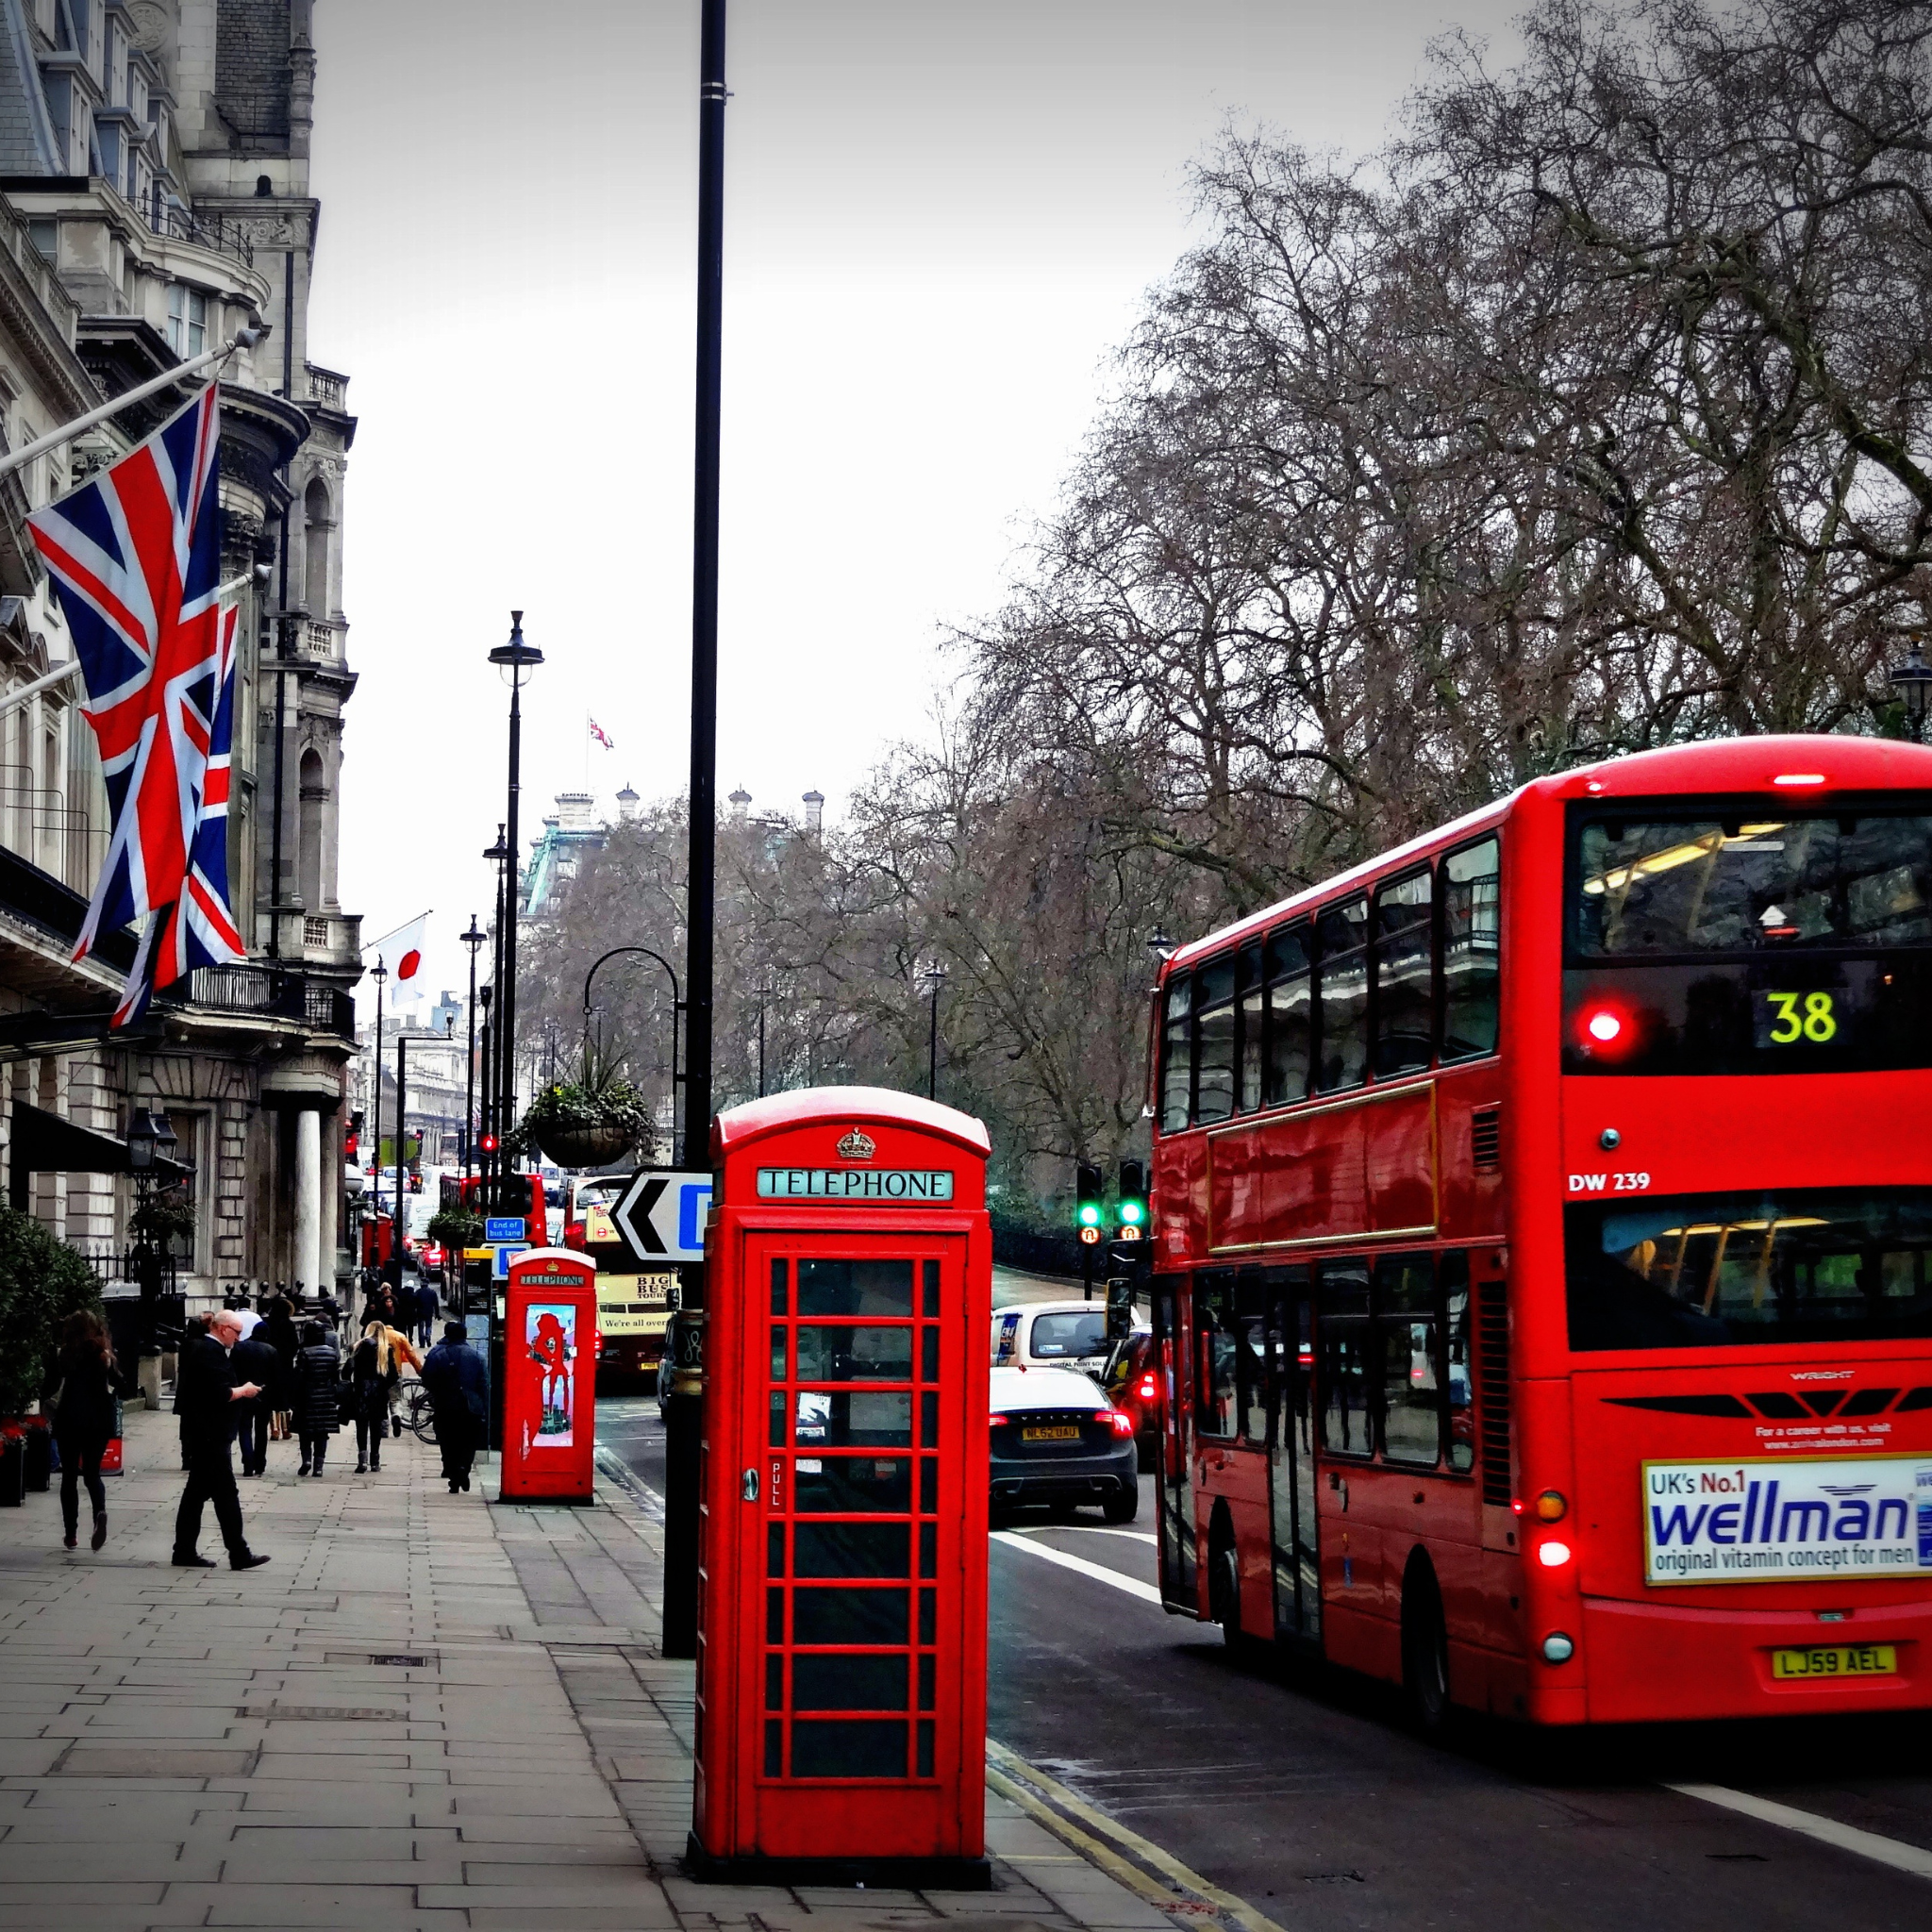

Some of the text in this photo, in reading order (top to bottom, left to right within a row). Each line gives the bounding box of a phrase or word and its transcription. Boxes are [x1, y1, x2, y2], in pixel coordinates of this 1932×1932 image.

[1767, 991, 1837, 1043] 38
[764, 1171, 945, 1196] TELEPHONE
[1568, 1173, 1651, 1191] DW 239
[524, 1275, 583, 1285] TELEPHONE
[637, 1276, 669, 1285] BIG
[637, 1285, 668, 1293] BUS
[1756, 1426, 1774, 1437] For
[1652, 1470, 1745, 1494] UK's No.1
[1651, 1480, 1908, 1546] wellman
[1656, 1543, 1914, 1575] original vitamin concept for men
[1781, 1650, 1887, 1674] LJ59 AEL
